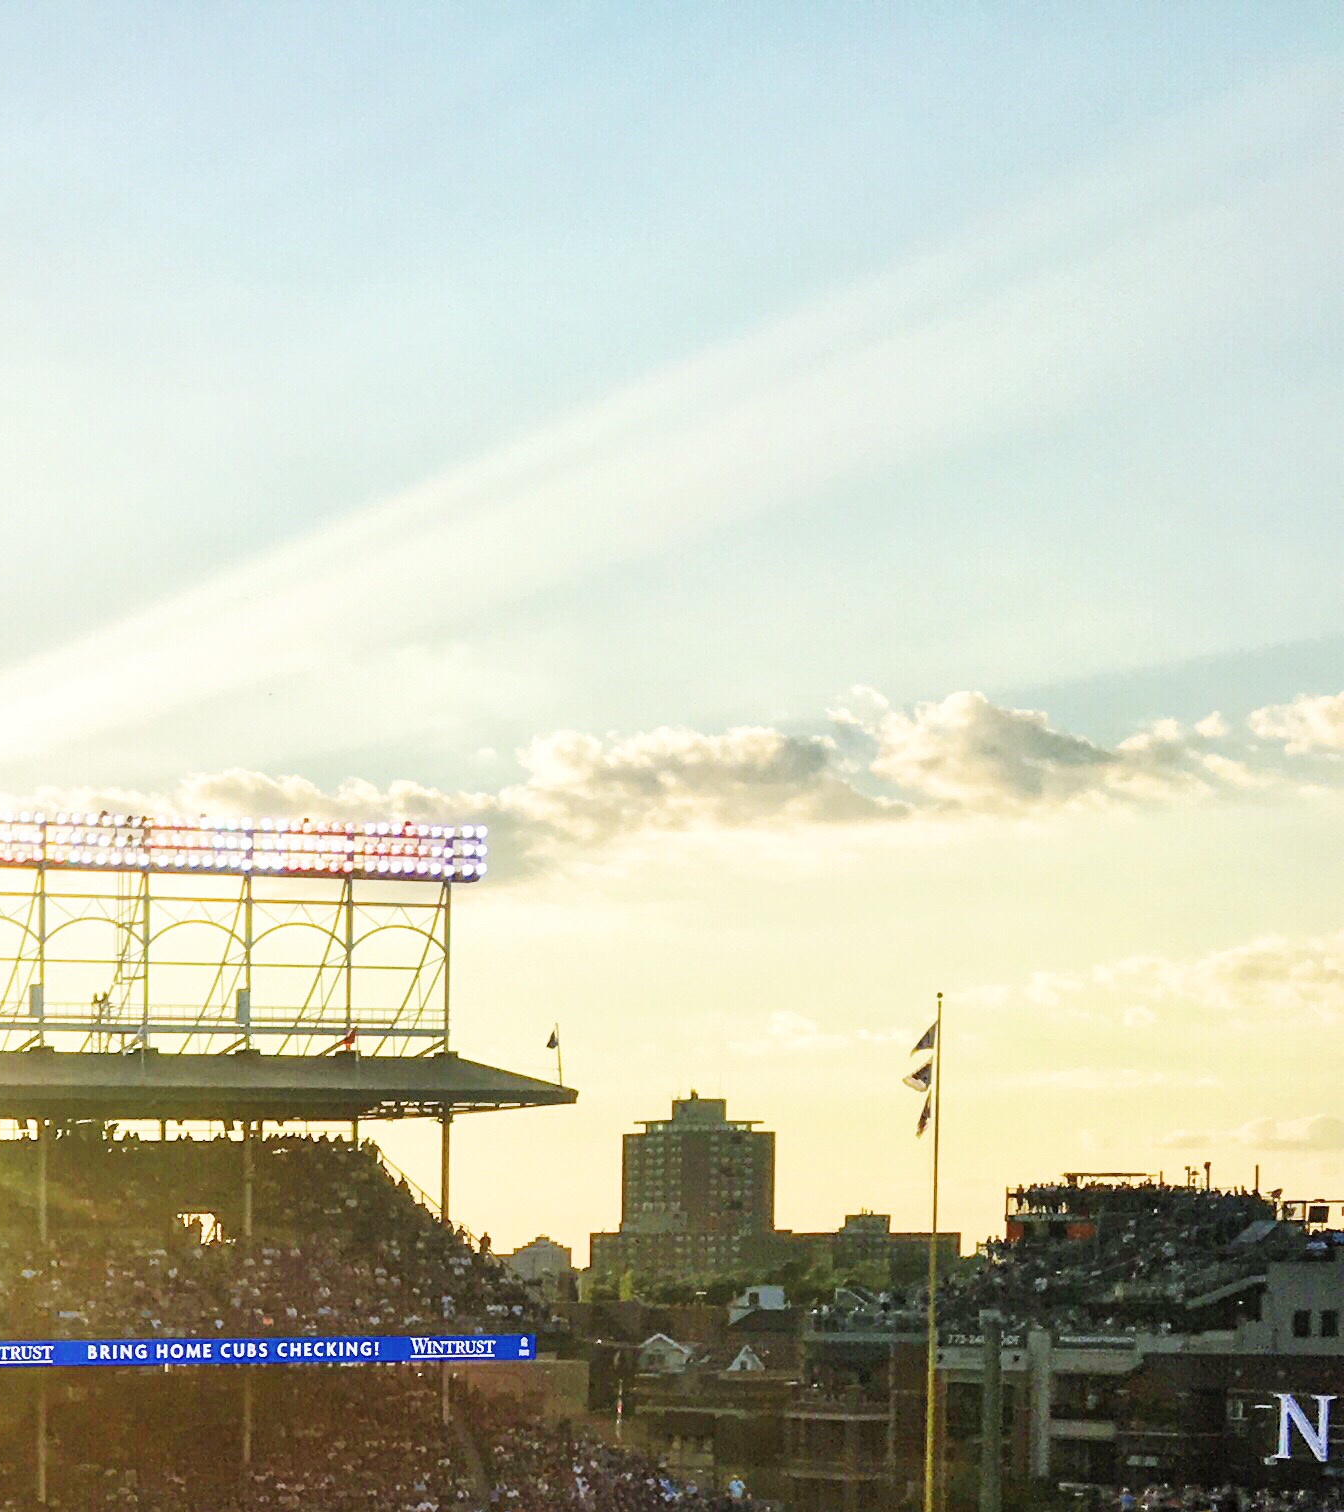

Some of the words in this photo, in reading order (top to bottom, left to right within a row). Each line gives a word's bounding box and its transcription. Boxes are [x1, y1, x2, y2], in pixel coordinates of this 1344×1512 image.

[87, 1344, 148, 1360] BRING
[156, 1343, 212, 1360] HOME
[220, 1342, 269, 1359] CUBS
[277, 1341, 380, 1358] CHECKING!
[410, 1337, 497, 1355] WINTRUST
